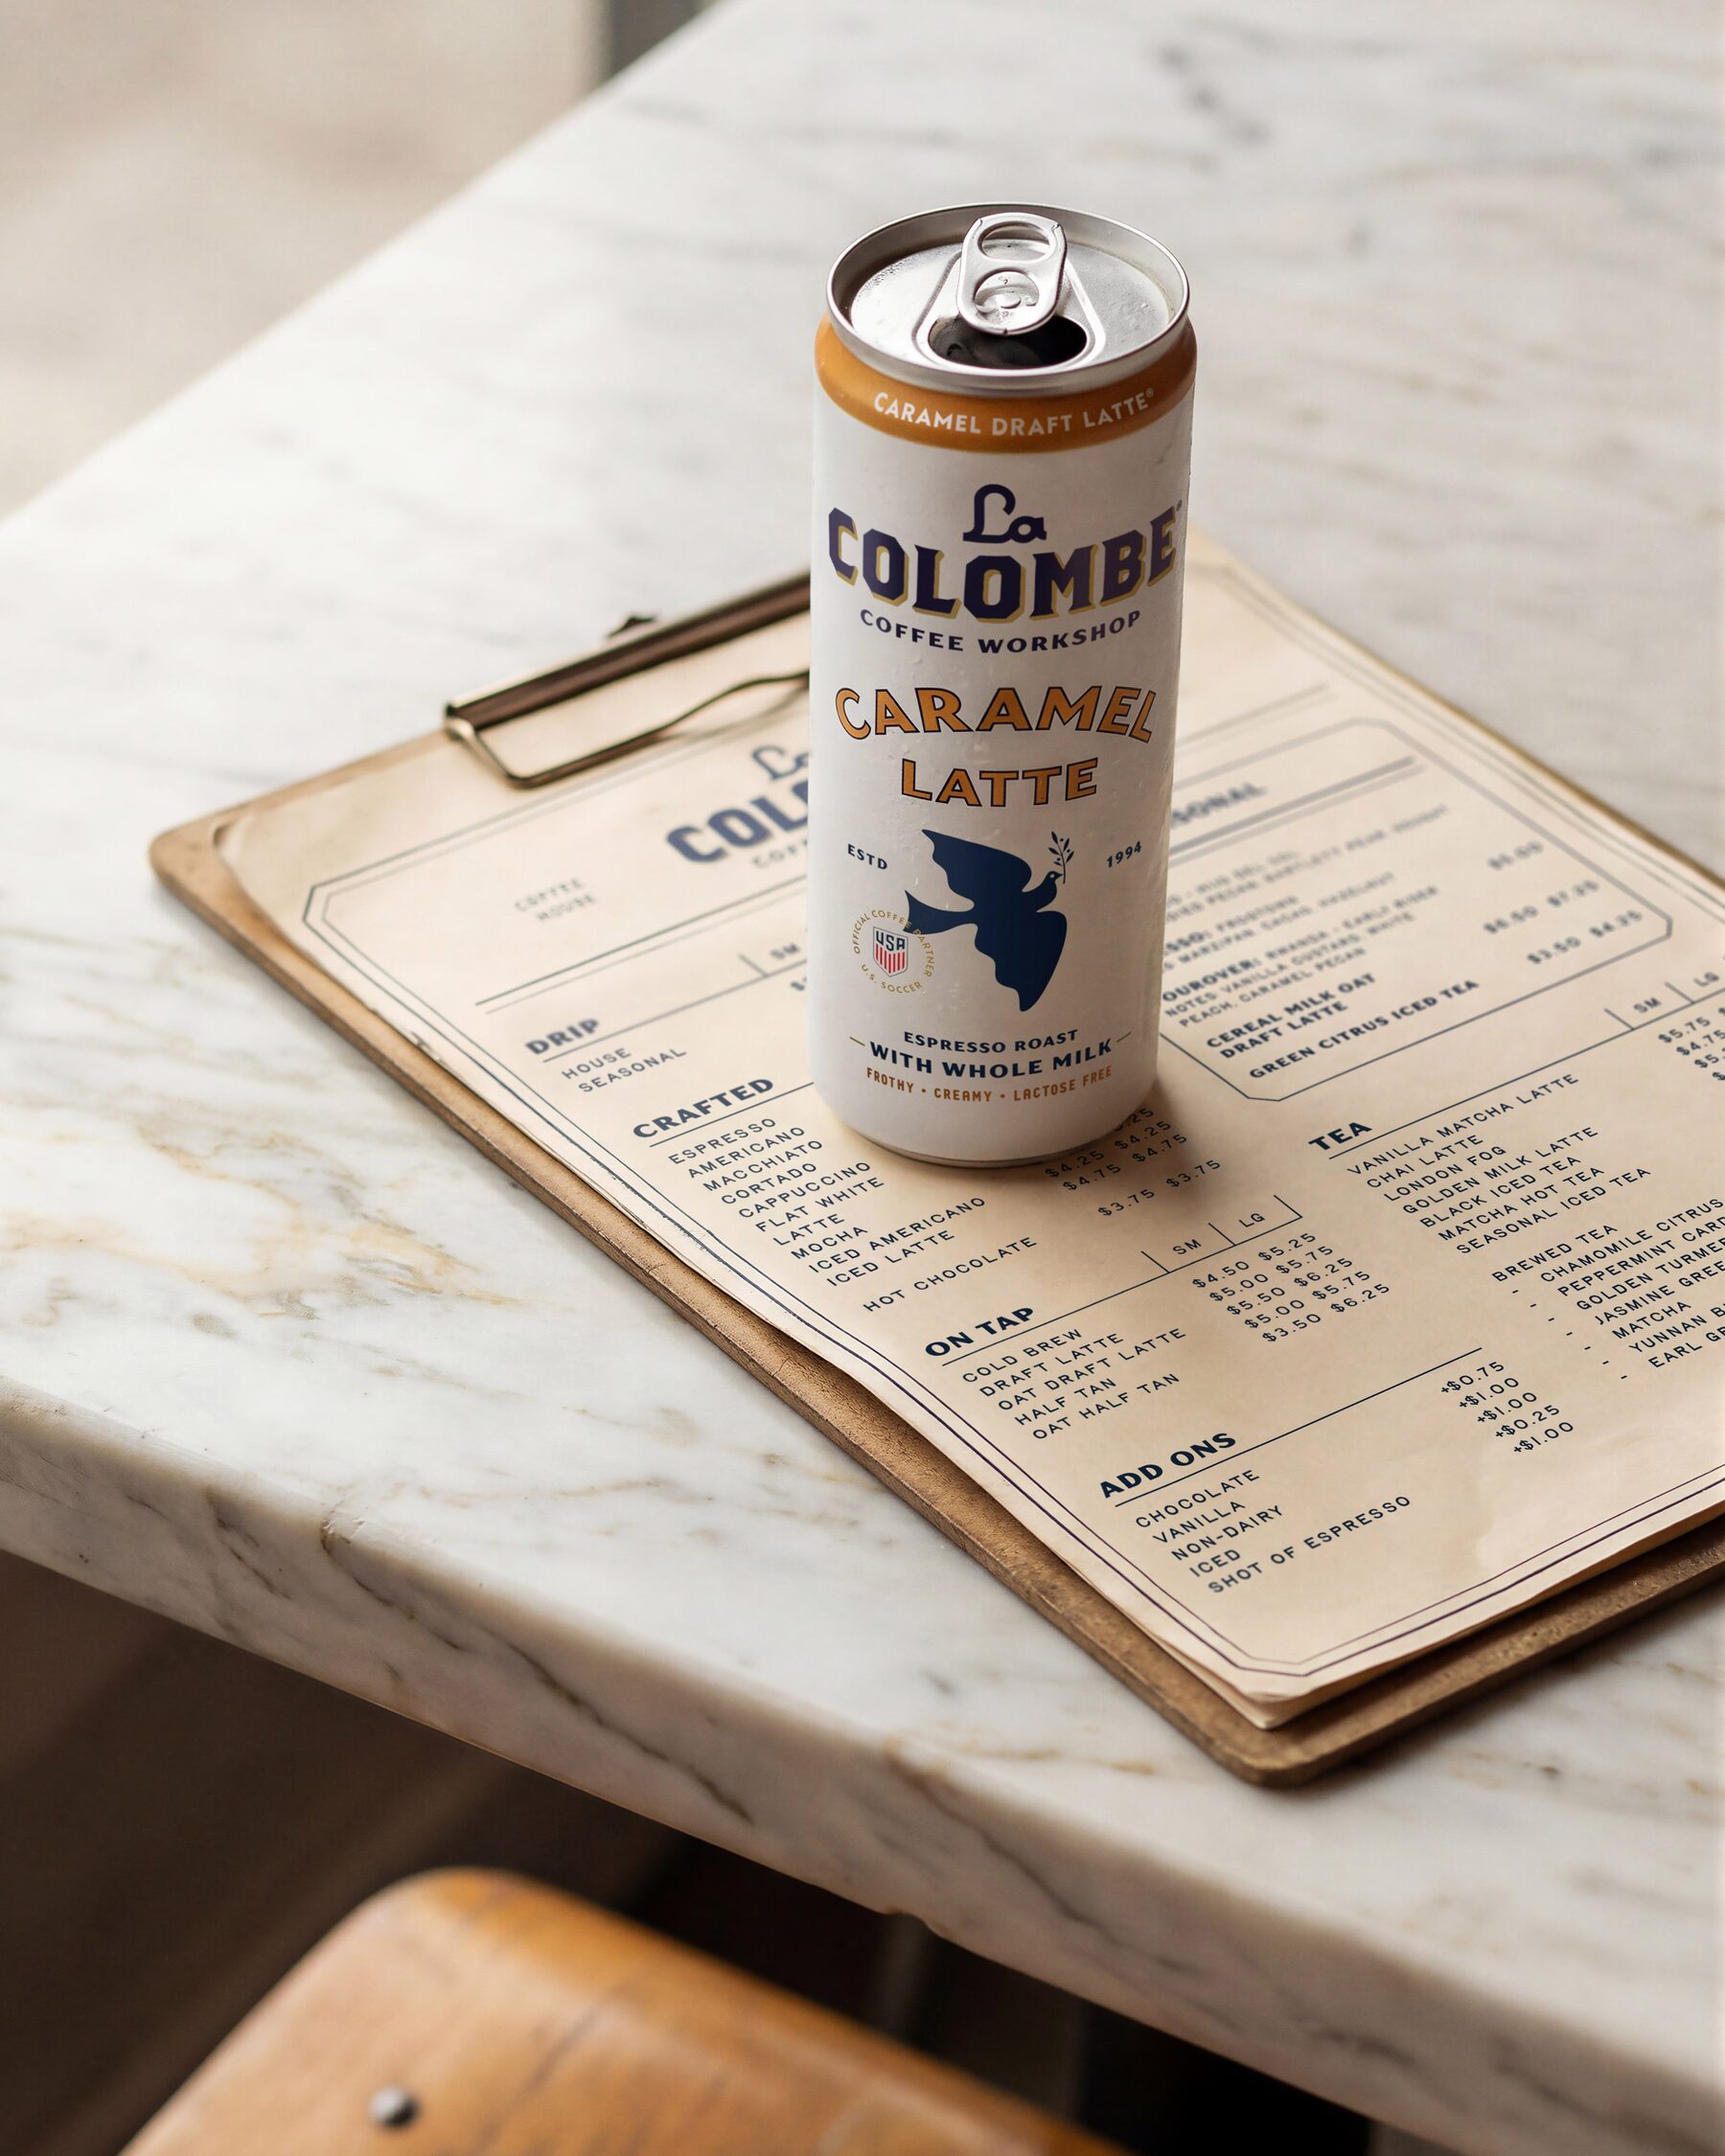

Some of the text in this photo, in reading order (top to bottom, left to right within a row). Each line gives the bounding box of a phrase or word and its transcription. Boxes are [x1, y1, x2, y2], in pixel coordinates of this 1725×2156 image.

[873, 391, 981, 434] CARAMEL
[991, 415, 1073, 436] DRAFT
[962, 483, 1047, 544] La
[860, 608, 1141, 654] COFFEE WORKSHOP
[835, 685, 1157, 744] CARAMEL
[901, 756, 1098, 807] LATTE
[847, 842, 888, 870] ESTD
[1106, 840, 1142, 868] 1994
[852, 909, 935, 978] OFFICIAL COFFEE PARTNER
[876, 929, 906, 952] USA
[862, 963, 923, 994] U.S. SOCCER
[1162, 957, 1262, 1001] OUROVER:
[1692, 972, 1720, 988] LG
[1206, 973, 1376, 1048] CEREAL MILK OAT
[1220, 1000, 1348, 1059] DRAFT LATTE
[1249, 979, 1480, 1079] GREEN CITRUS ICED TEA
[1633, 997, 1663, 1014] SM
[1658, 1017, 1711, 1044] $5.75
[523, 1018, 601, 1056] DRIP
[869, 1038, 1113, 1079] WITH WHOLE MILK
[904, 1029, 1079, 1054] ESPRESSO ROAST
[561, 1047, 632, 1080] HOUSE
[578, 1046, 687, 1093] SEASONAL
[866, 1065, 1113, 1102] FROTHY CREAMY LACTOSE FREE
[633, 1079, 773, 1137] CRAFTED
[1346, 1074, 1578, 1175] VANILLA MATCHA LATTE
[668, 1118, 775, 1164] ESPRESSO
[688, 1128, 804, 1179] AMERICANO
[1045, 1121, 1171, 1178] $4.25 $4.25
[1063, 1134, 1186, 1190] $4.75 $4.75
[1308, 1122, 1372, 1151] TEA
[1367, 1135, 1484, 1188] CHAI LATTE
[702, 1140, 822, 1191] MACCHIATO
[722, 1163, 816, 1204] CORTADO
[739, 1162, 870, 1218] CAPPUCCINO
[1098, 1159, 1220, 1216] $3.75 $3.75
[1384, 1146, 1506, 1202] LONDON FOG
[1403, 1127, 1598, 1214] GOLDEN MILK LATTE
[755, 1177, 885, 1232] FLAT WHITE
[1419, 1157, 1581, 1227] BLACK ICED TEA
[1438, 1167, 1604, 1241] MATCHA HOT TEA
[1457, 1168, 1651, 1253] SEASONAL ICED TEA
[772, 1213, 845, 1246] LATTE
[791, 1227, 868, 1259] MOCHA
[808, 1198, 985, 1273] ICED AMERICANO
[1238, 1213, 1265, 1227] LG
[1540, 1199, 1724, 1282] CHAMOMILE CITRUS
[826, 1230, 954, 1286] ICED LATTE
[1172, 1239, 1202, 1255] SM
[1192, 1233, 1316, 1288] $4.50 $5.25
[1491, 1225, 1618, 1282] BREWED TEA
[1557, 1240, 1675, 1296] PEPPERMINT
[862, 1237, 1037, 1312] HOT CHOCOLATE
[1209, 1246, 1333, 1301] $5.00 $5.75
[1227, 1258, 1352, 1315] $5.50 $6.25
[1576, 1273, 1653, 1310] GOLDEN
[1244, 1271, 1370, 1328] $5.00 $5.75
[1262, 1284, 1390, 1342] $3.50 $6.25
[1595, 1285, 1675, 1325] JASMINE
[1611, 1301, 1691, 1339] MATCHA
[925, 1308, 1033, 1357] ON TAP
[962, 1329, 1082, 1383] COLD BREW
[1628, 1315, 1708, 1353] YUNNAN
[1648, 1342, 1703, 1367] EARL
[979, 1333, 1124, 1397] DRAFT LATTE
[998, 1328, 1186, 1411] OAT DRAFT LATTE
[1441, 1362, 1505, 1393] +$0.75
[1014, 1378, 1116, 1426] HALF TAN
[1032, 1373, 1180, 1439] OAT HALF TAN
[1459, 1378, 1519, 1408] +$1.00
[1477, 1392, 1537, 1422] +$1.00
[1495, 1405, 1559, 1437] +$0.25
[1513, 1422, 1574, 1453] +$1.00
[1100, 1433, 1236, 1499] ADD ONS
[1136, 1470, 1260, 1527] CHOCOLATE
[1152, 1502, 1246, 1543] VANILLA
[1171, 1505, 1282, 1561] NON-DAIRY
[1208, 1497, 1410, 1593] SHOT OF ESPRESSO
[1189, 1549, 1240, 1577] ICED
